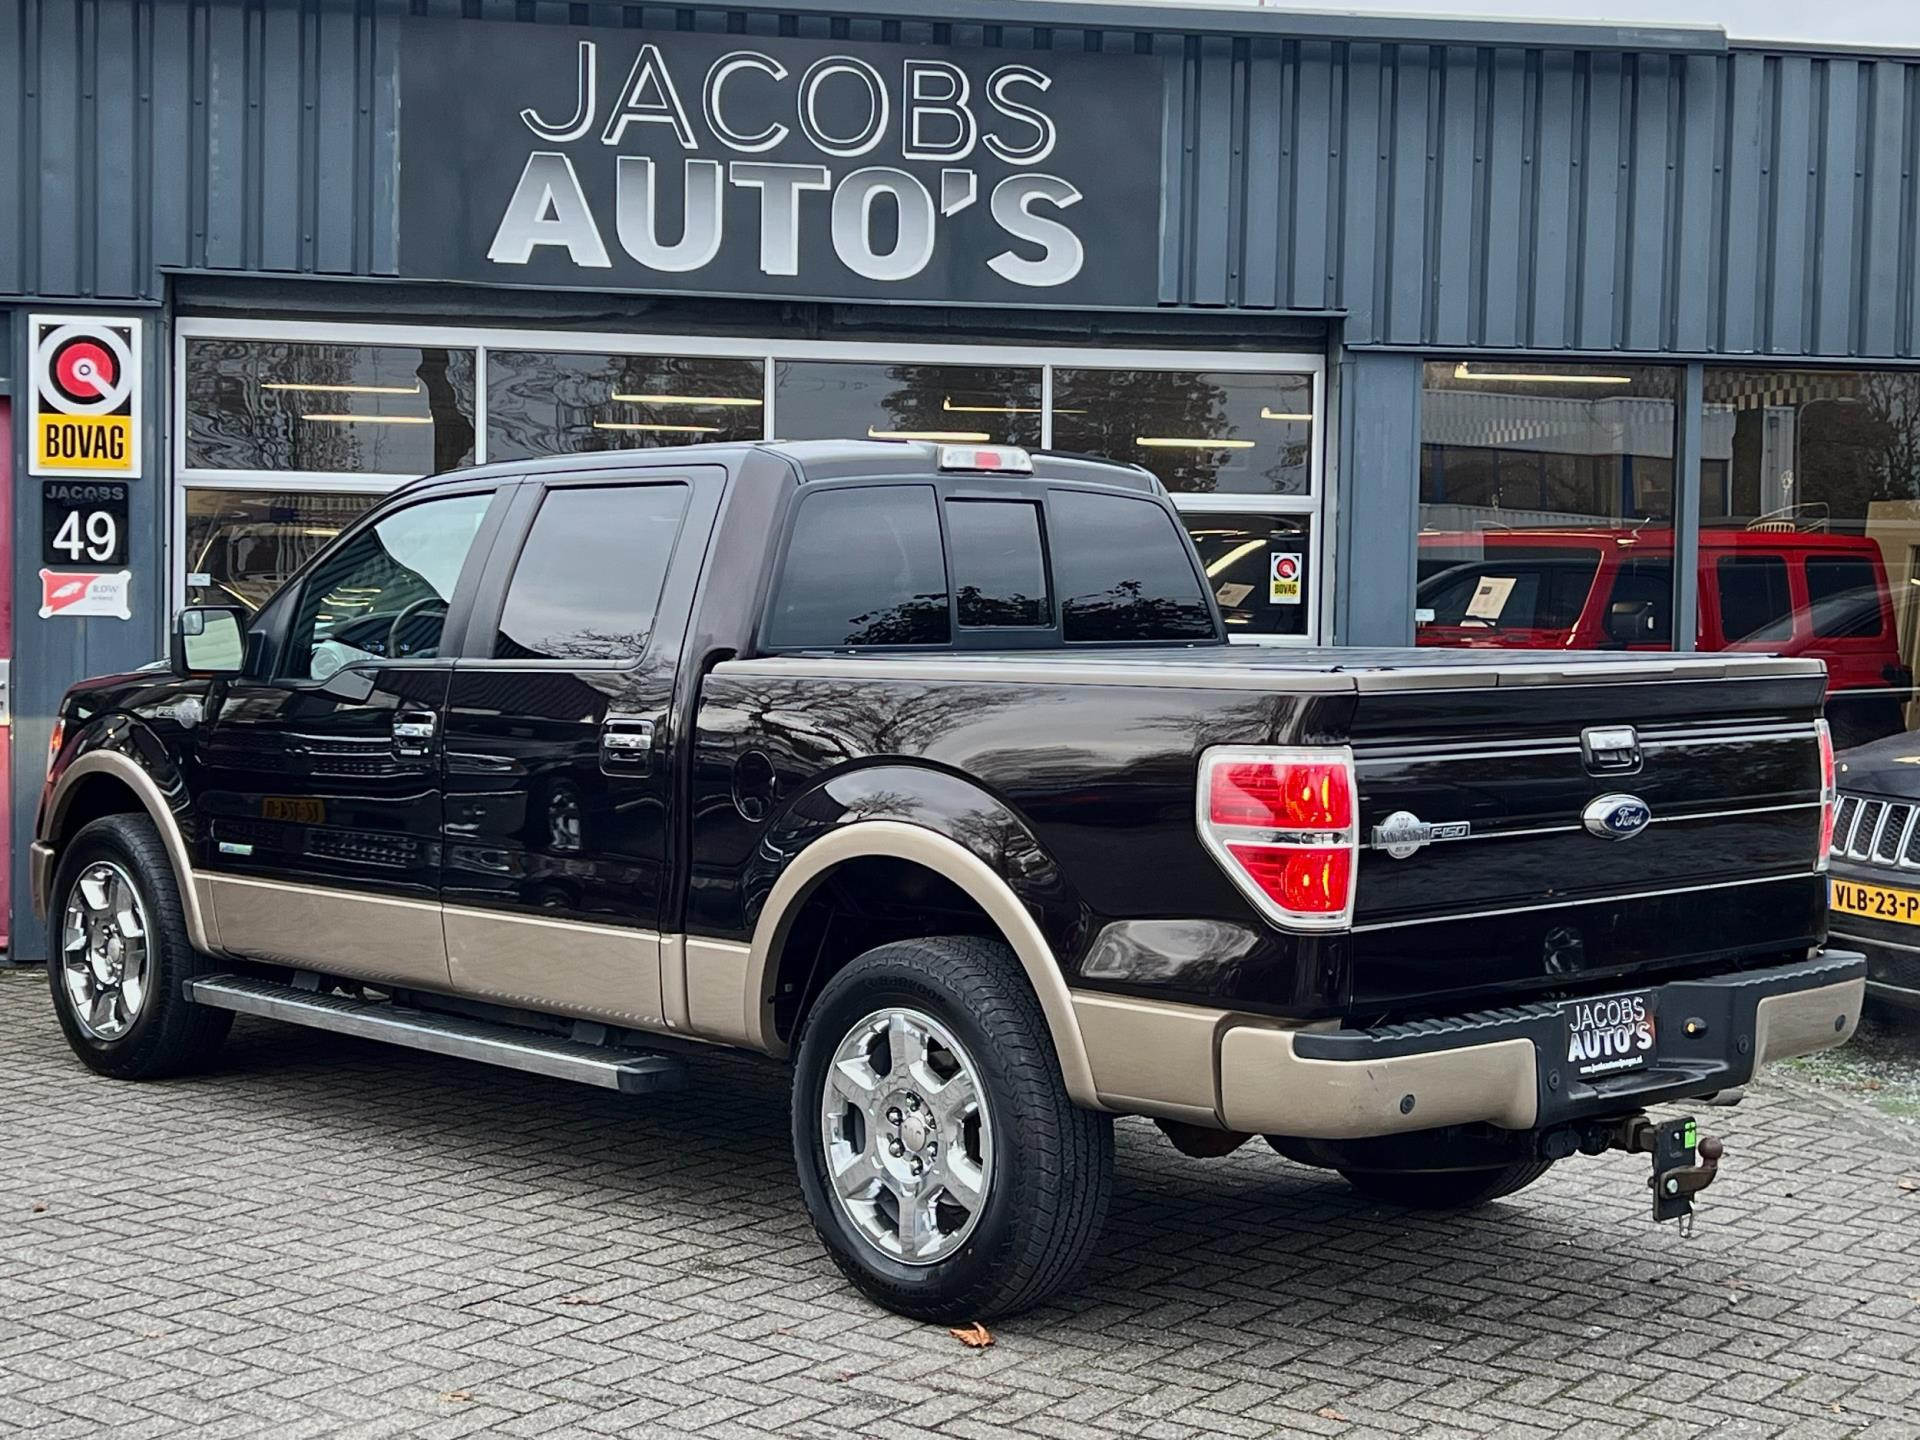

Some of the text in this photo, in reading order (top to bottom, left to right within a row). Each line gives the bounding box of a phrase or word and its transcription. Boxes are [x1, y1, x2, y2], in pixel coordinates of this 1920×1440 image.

[520, 41, 1056, 165] JACOBS
[487, 151, 1083, 287] AUTO'S
[46, 424, 124, 459] BOVAG
[45, 485, 124, 500] JACOBS
[52, 510, 116, 561] 49
[1615, 807, 1643, 827] Ford
[1835, 884, 1919, 919] VLB-23-P
[1569, 996, 1646, 1032] JACOBS
[1567, 1021, 1653, 1062] AUTO'S
